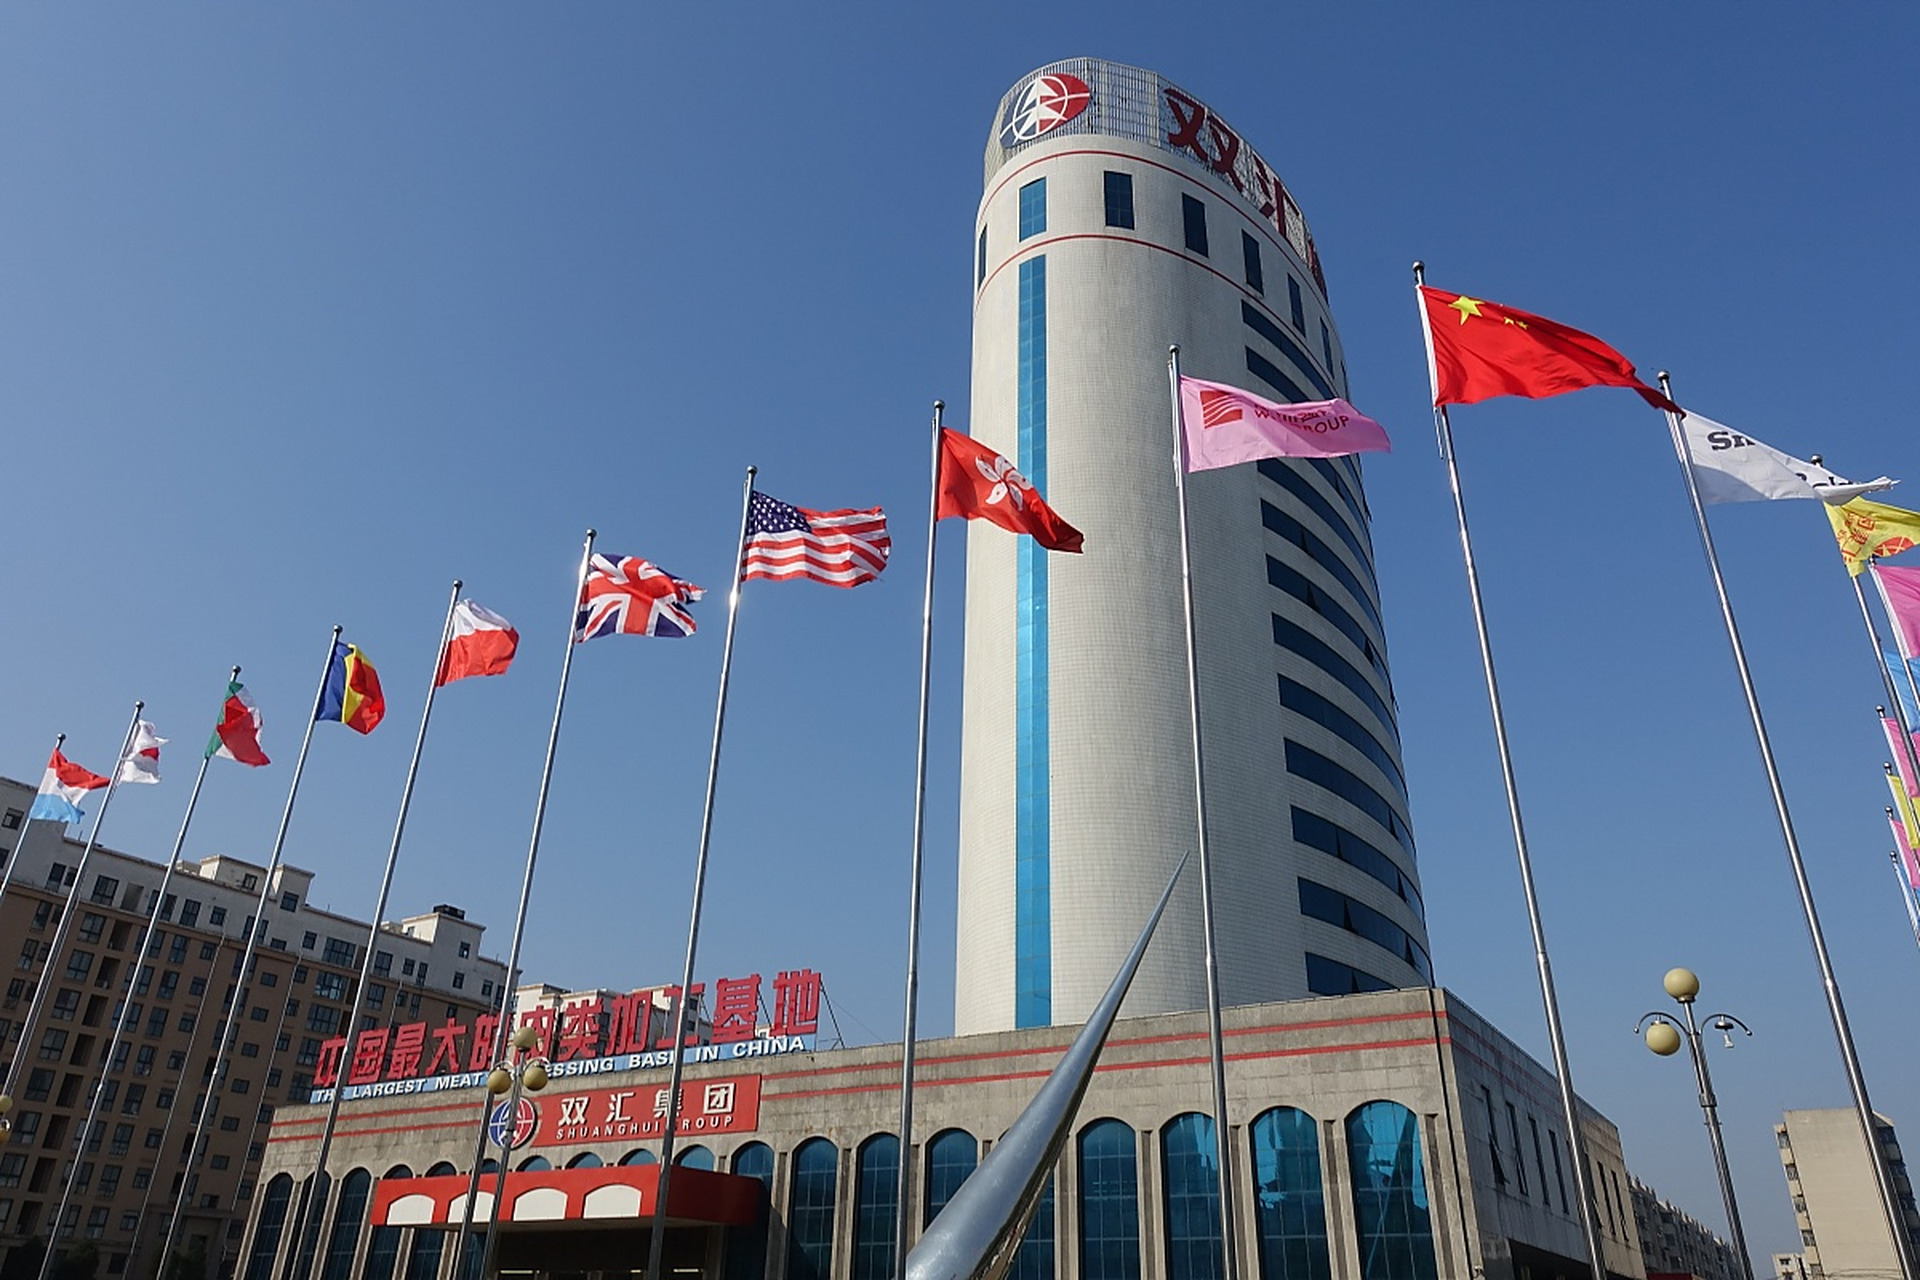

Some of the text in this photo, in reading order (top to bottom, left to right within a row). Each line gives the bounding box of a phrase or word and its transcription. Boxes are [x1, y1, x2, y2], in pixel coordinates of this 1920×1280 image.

[313, 968, 822, 1087] 中国最大的肉类加工基地
[315, 1087, 345, 1102] TH
[352, 1078, 426, 1099] LARGEST
[434, 1071, 486, 1090] MEAT
[695, 1045, 718, 1062] IN
[732, 1035, 805, 1058] CHINA
[556, 1115, 733, 1140] SHUANGHUI ROUP
[558, 1083, 735, 1126] 双汇集团
